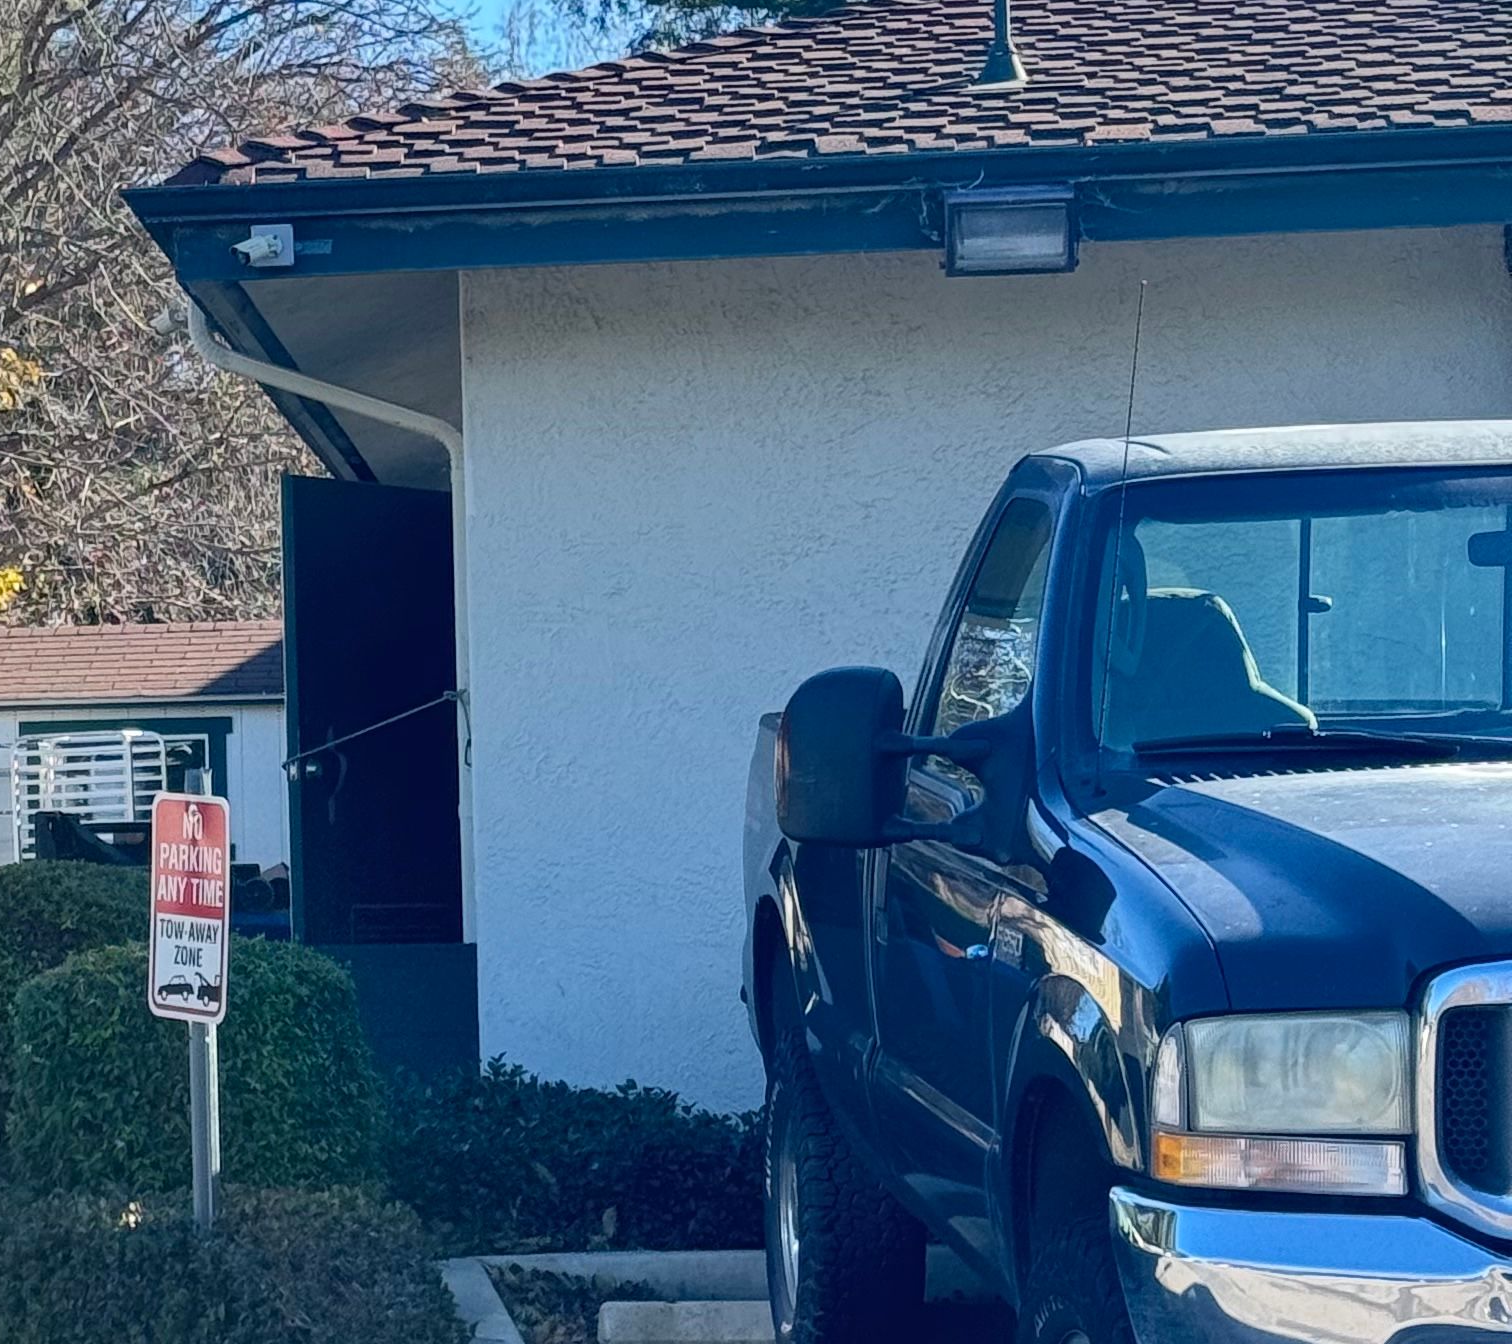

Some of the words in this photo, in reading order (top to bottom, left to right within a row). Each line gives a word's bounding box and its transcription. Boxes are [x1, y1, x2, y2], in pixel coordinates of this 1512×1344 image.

[183, 810, 203, 841] NO
[159, 842, 223, 875] PARKING
[157, 874, 188, 905] ANY
[190, 877, 224, 908] TIME
[159, 918, 220, 945] TOW-AWAY
[174, 944, 203, 968] ZONE
